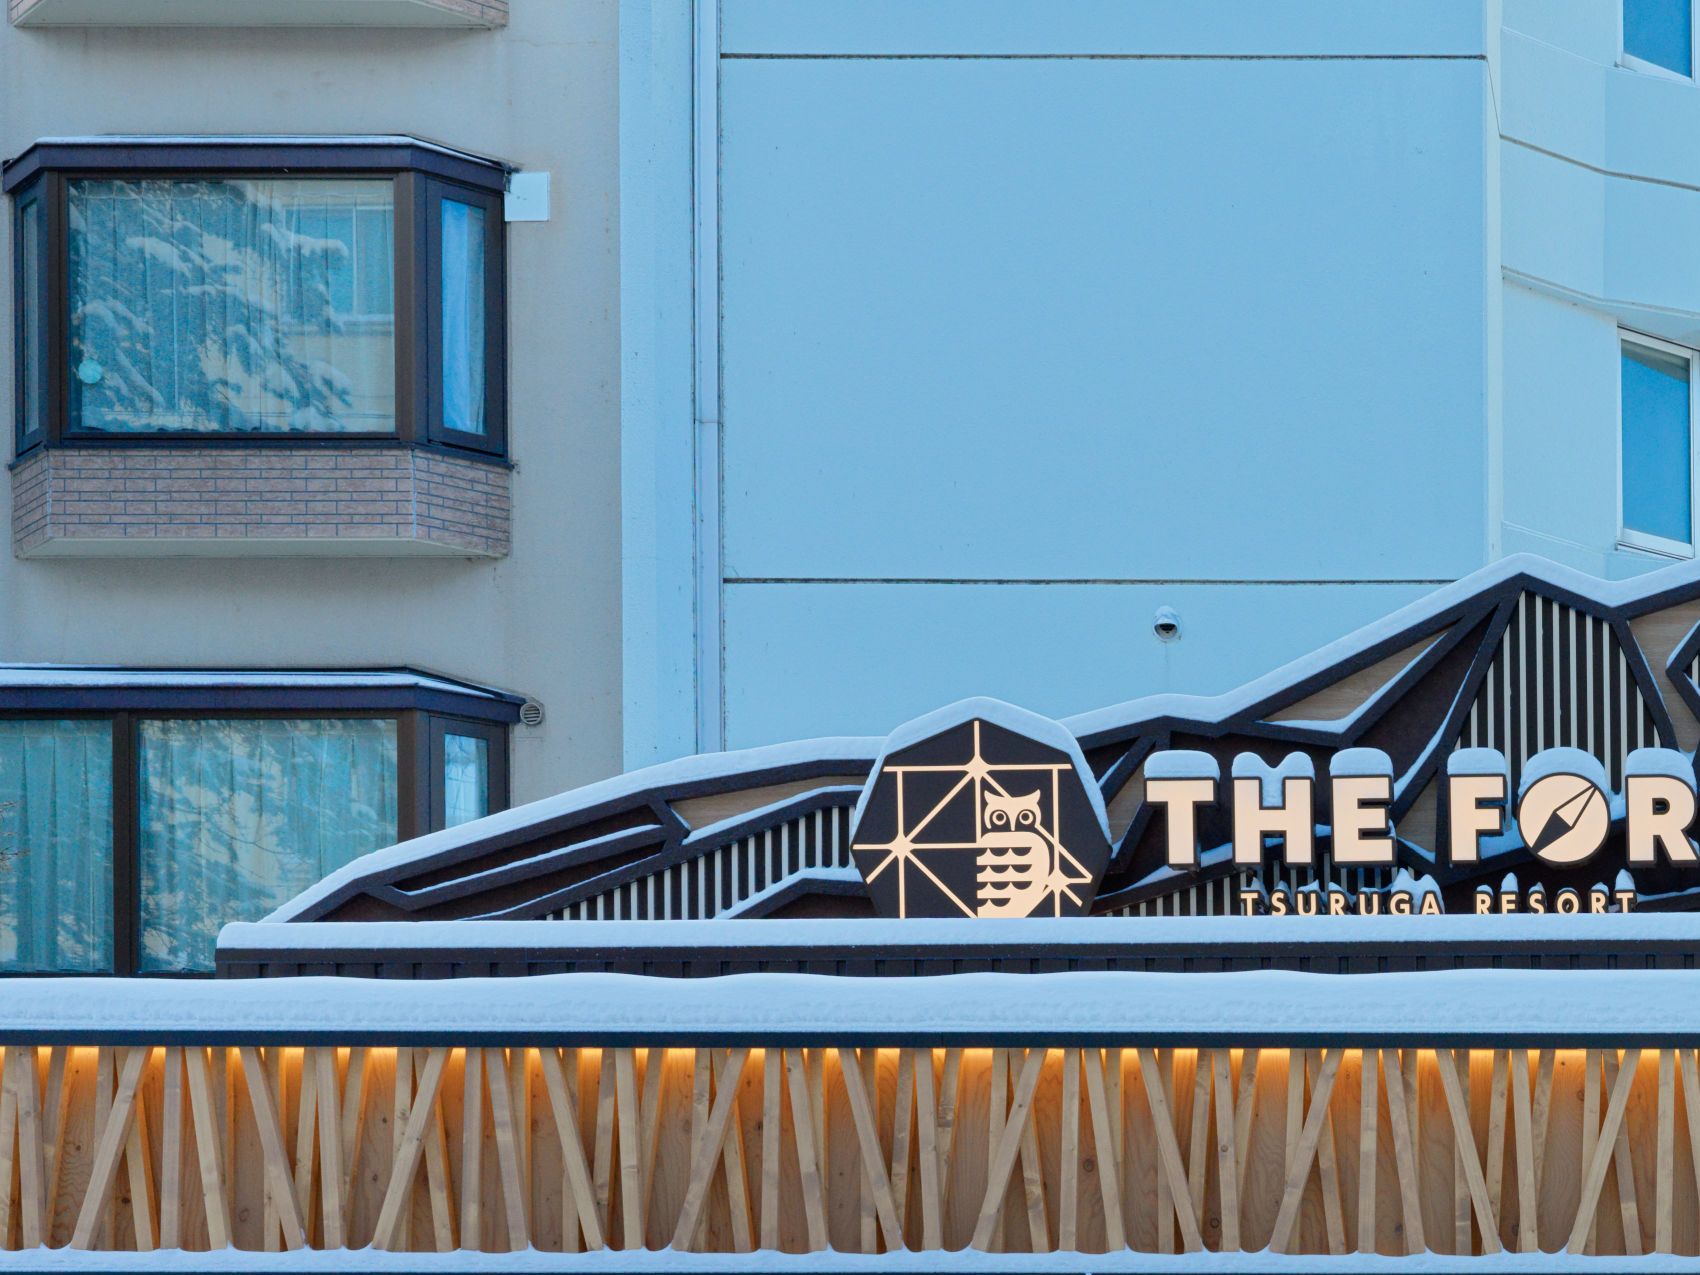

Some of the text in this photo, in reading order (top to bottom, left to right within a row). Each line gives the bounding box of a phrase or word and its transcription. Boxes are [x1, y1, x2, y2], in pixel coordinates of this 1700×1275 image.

[1145, 775, 1395, 867] THE
[1240, 890, 1635, 915] TSURUGA RESORT
